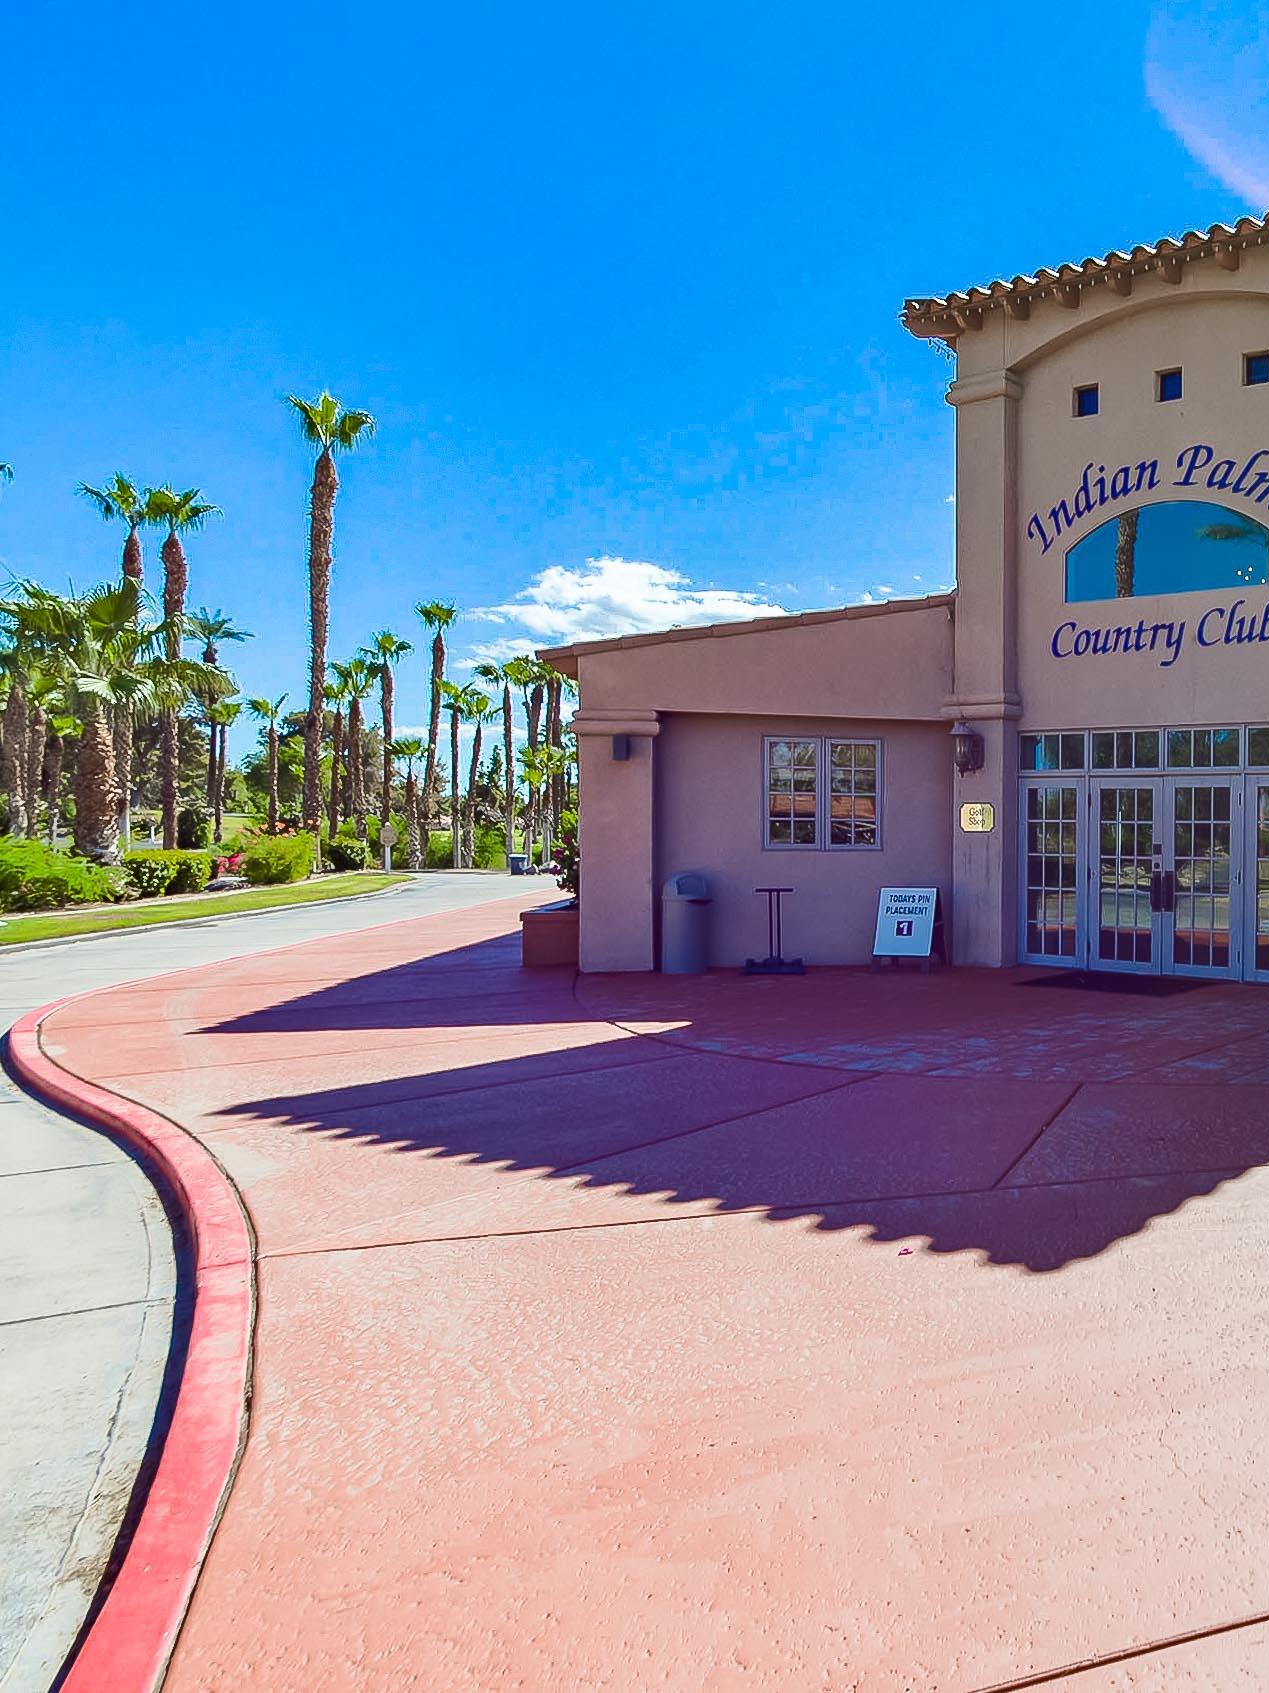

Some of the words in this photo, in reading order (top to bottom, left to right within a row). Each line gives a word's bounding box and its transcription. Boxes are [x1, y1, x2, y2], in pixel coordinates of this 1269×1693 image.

[1027, 459, 1160, 555] Indian
[1051, 619, 1186, 667] Country
[968, 807, 985, 817] Golf
[917, 894, 931, 904] PIN
[885, 905, 929, 916] PLACEMENT
[899, 921, 909, 935] 1
